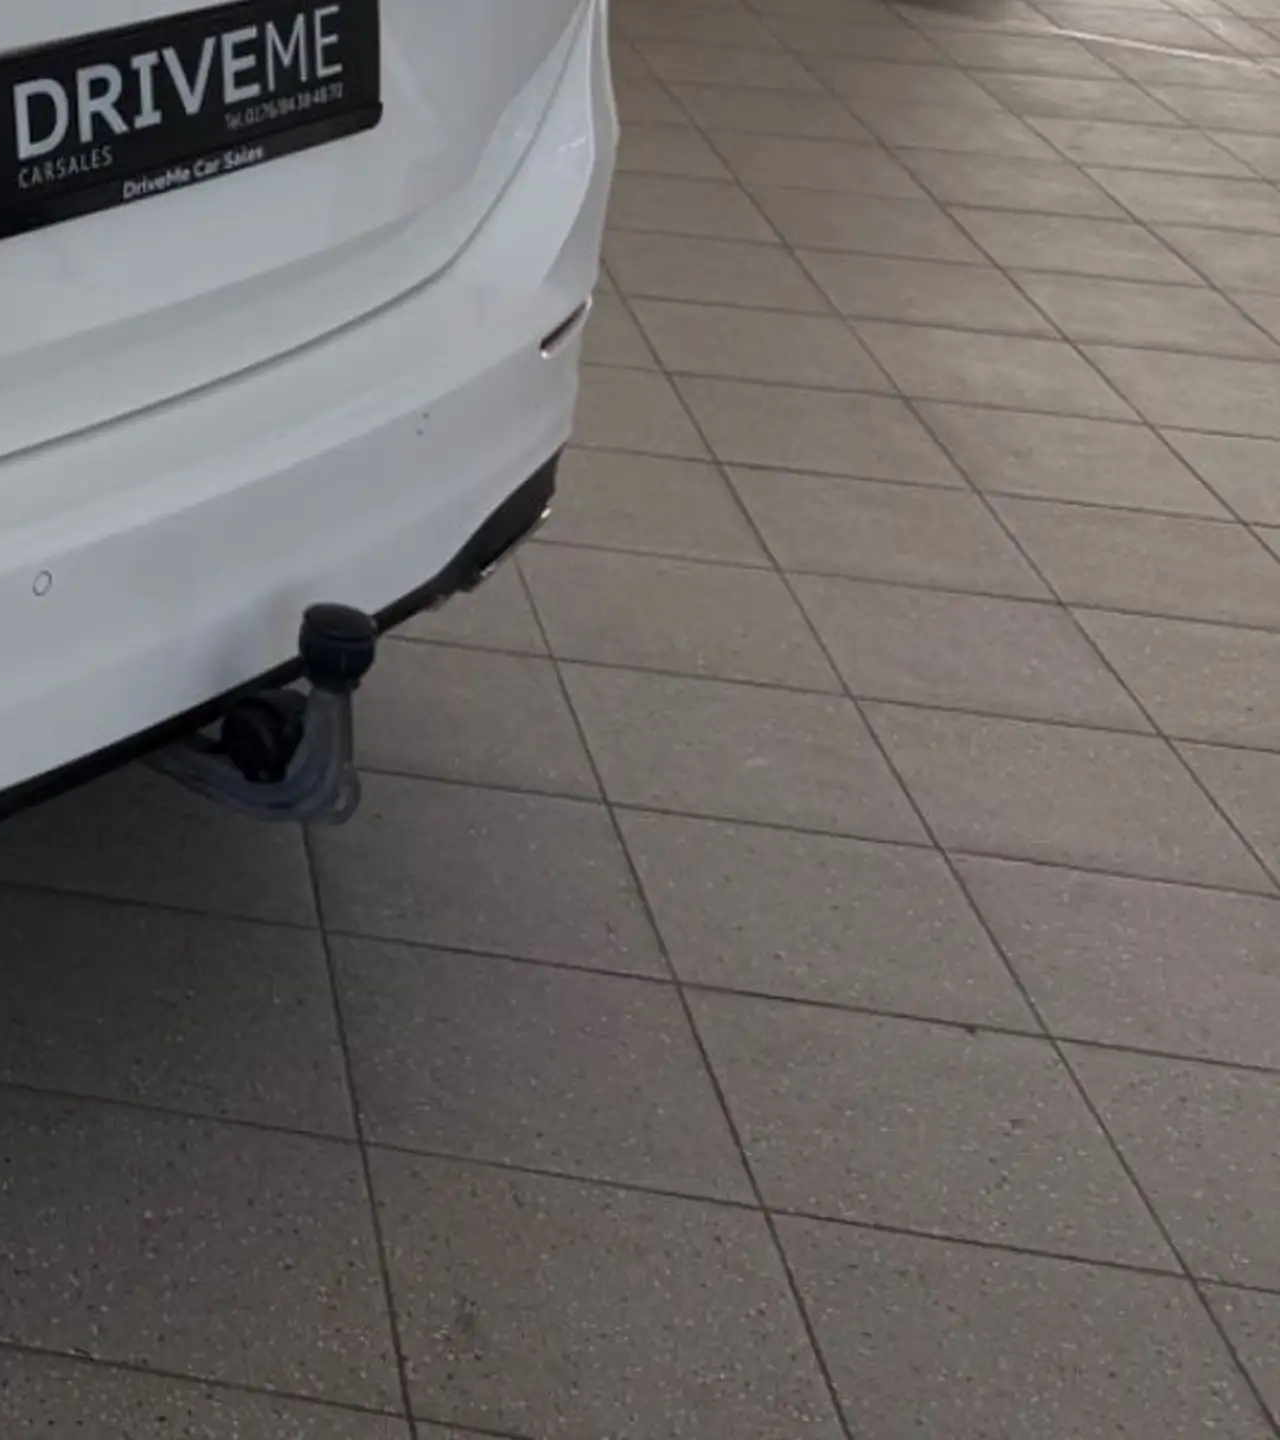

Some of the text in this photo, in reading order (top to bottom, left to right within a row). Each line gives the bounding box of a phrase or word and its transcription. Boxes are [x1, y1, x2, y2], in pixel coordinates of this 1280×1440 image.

[13, 5, 343, 160] DRIVEME
[18, 145, 113, 189] CARSALES
[122, 145, 264, 200] DriveMe Car Sales
